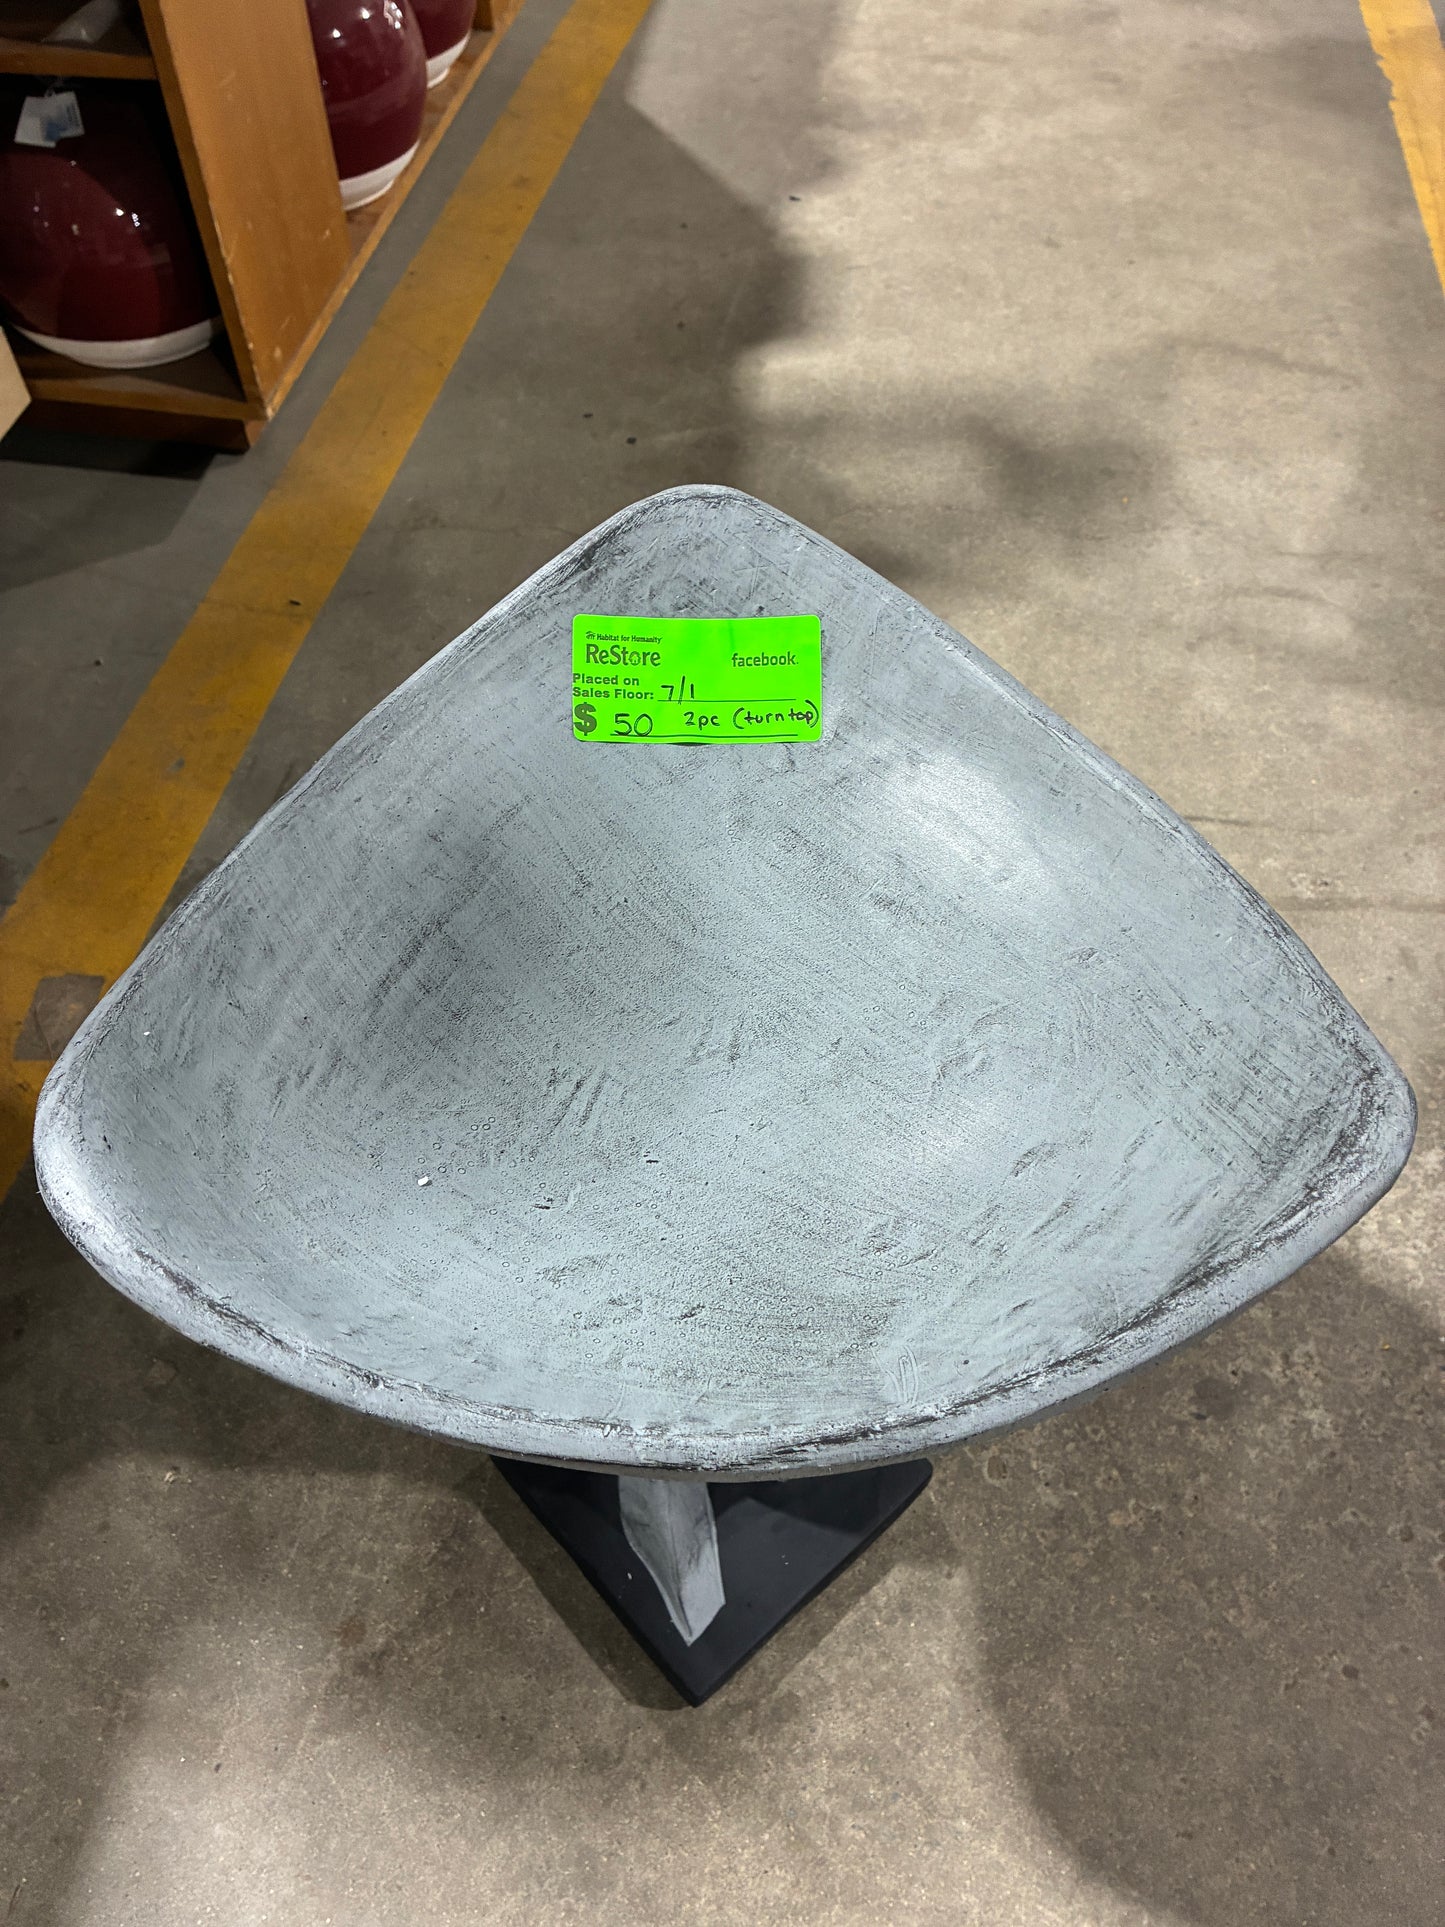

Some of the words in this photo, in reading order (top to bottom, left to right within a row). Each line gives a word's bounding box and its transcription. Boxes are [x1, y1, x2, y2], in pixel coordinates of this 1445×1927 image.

[596, 633, 619, 642] Habitat
[621, 634, 630, 642] for
[631, 635, 662, 644] Humanity
[585, 643, 661, 667] ReStore
[573, 673, 619, 685] Placed
[623, 677, 640, 686] on
[573, 687, 610, 698] Sales
[614, 688, 654, 700] Floor:
[661, 675, 695, 705] 7/1
[574, 701, 598, 736] $
[614, 713, 653, 737] 50
